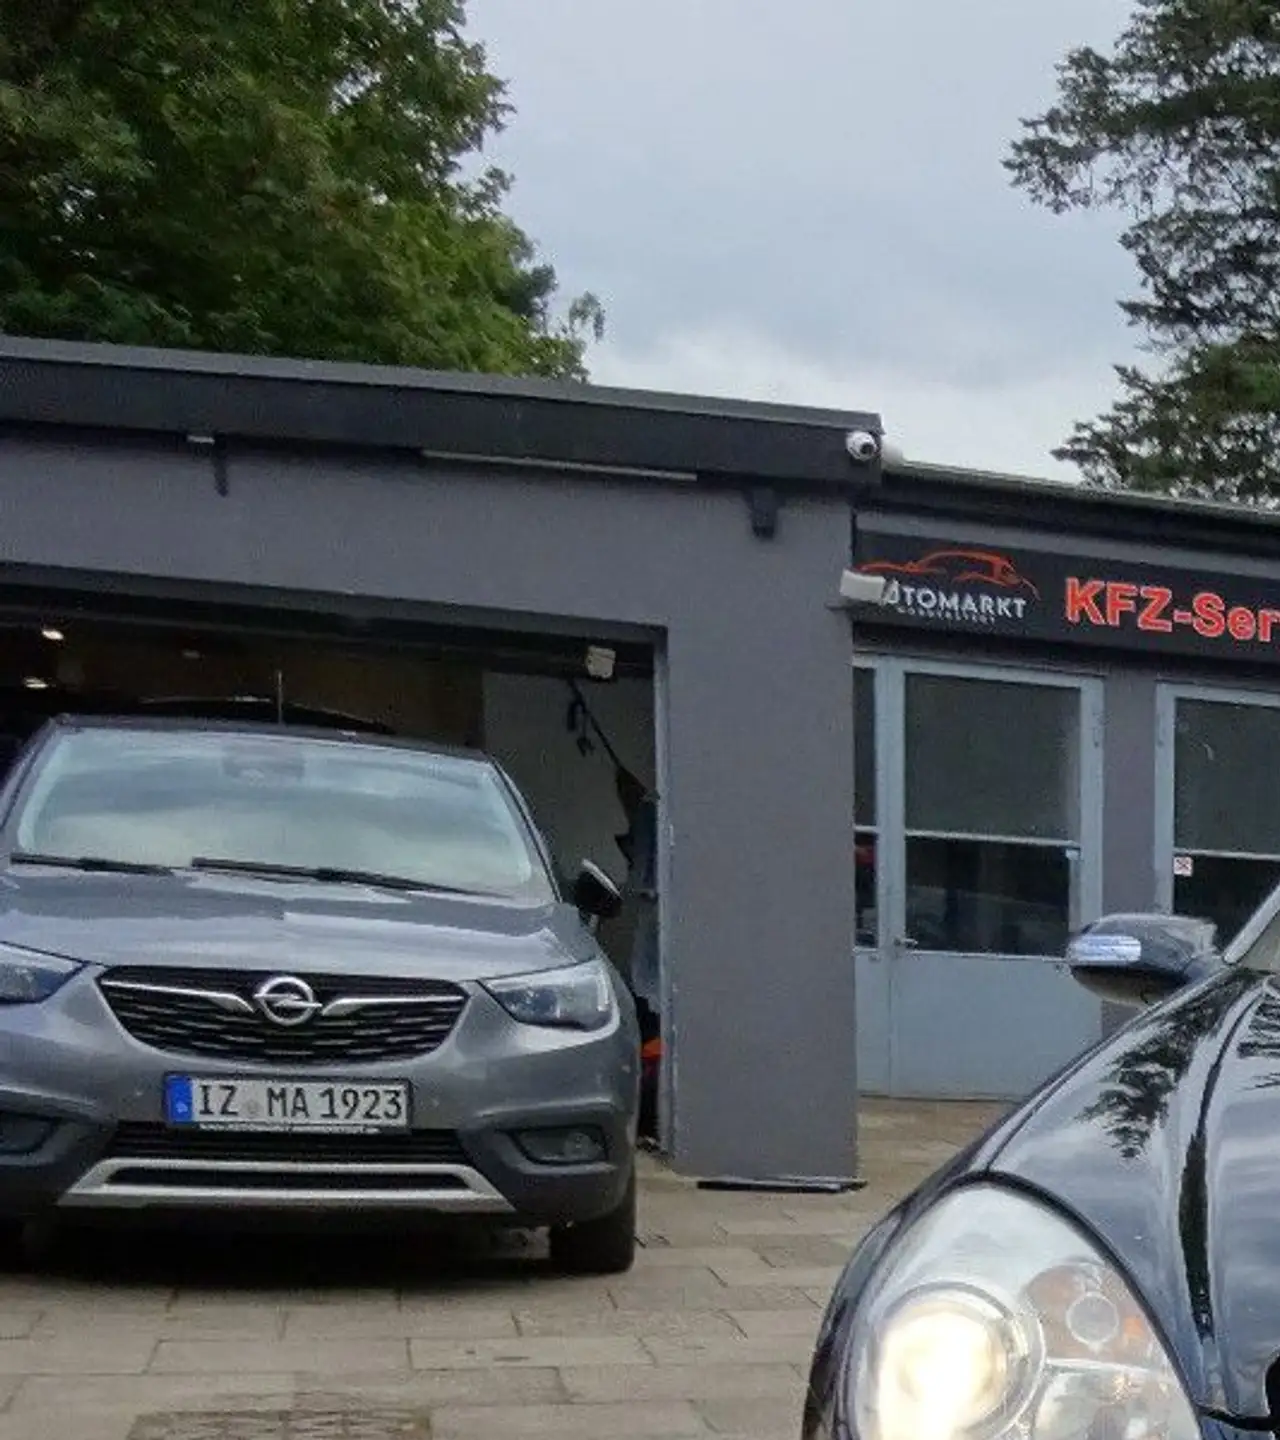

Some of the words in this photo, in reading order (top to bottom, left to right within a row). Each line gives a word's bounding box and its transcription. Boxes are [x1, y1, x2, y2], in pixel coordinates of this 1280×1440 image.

[881, 576, 1027, 619] TOMARKT
[199, 1084, 239, 1116] IZ
[267, 1087, 310, 1118] MA
[319, 1087, 402, 1121] 1923
